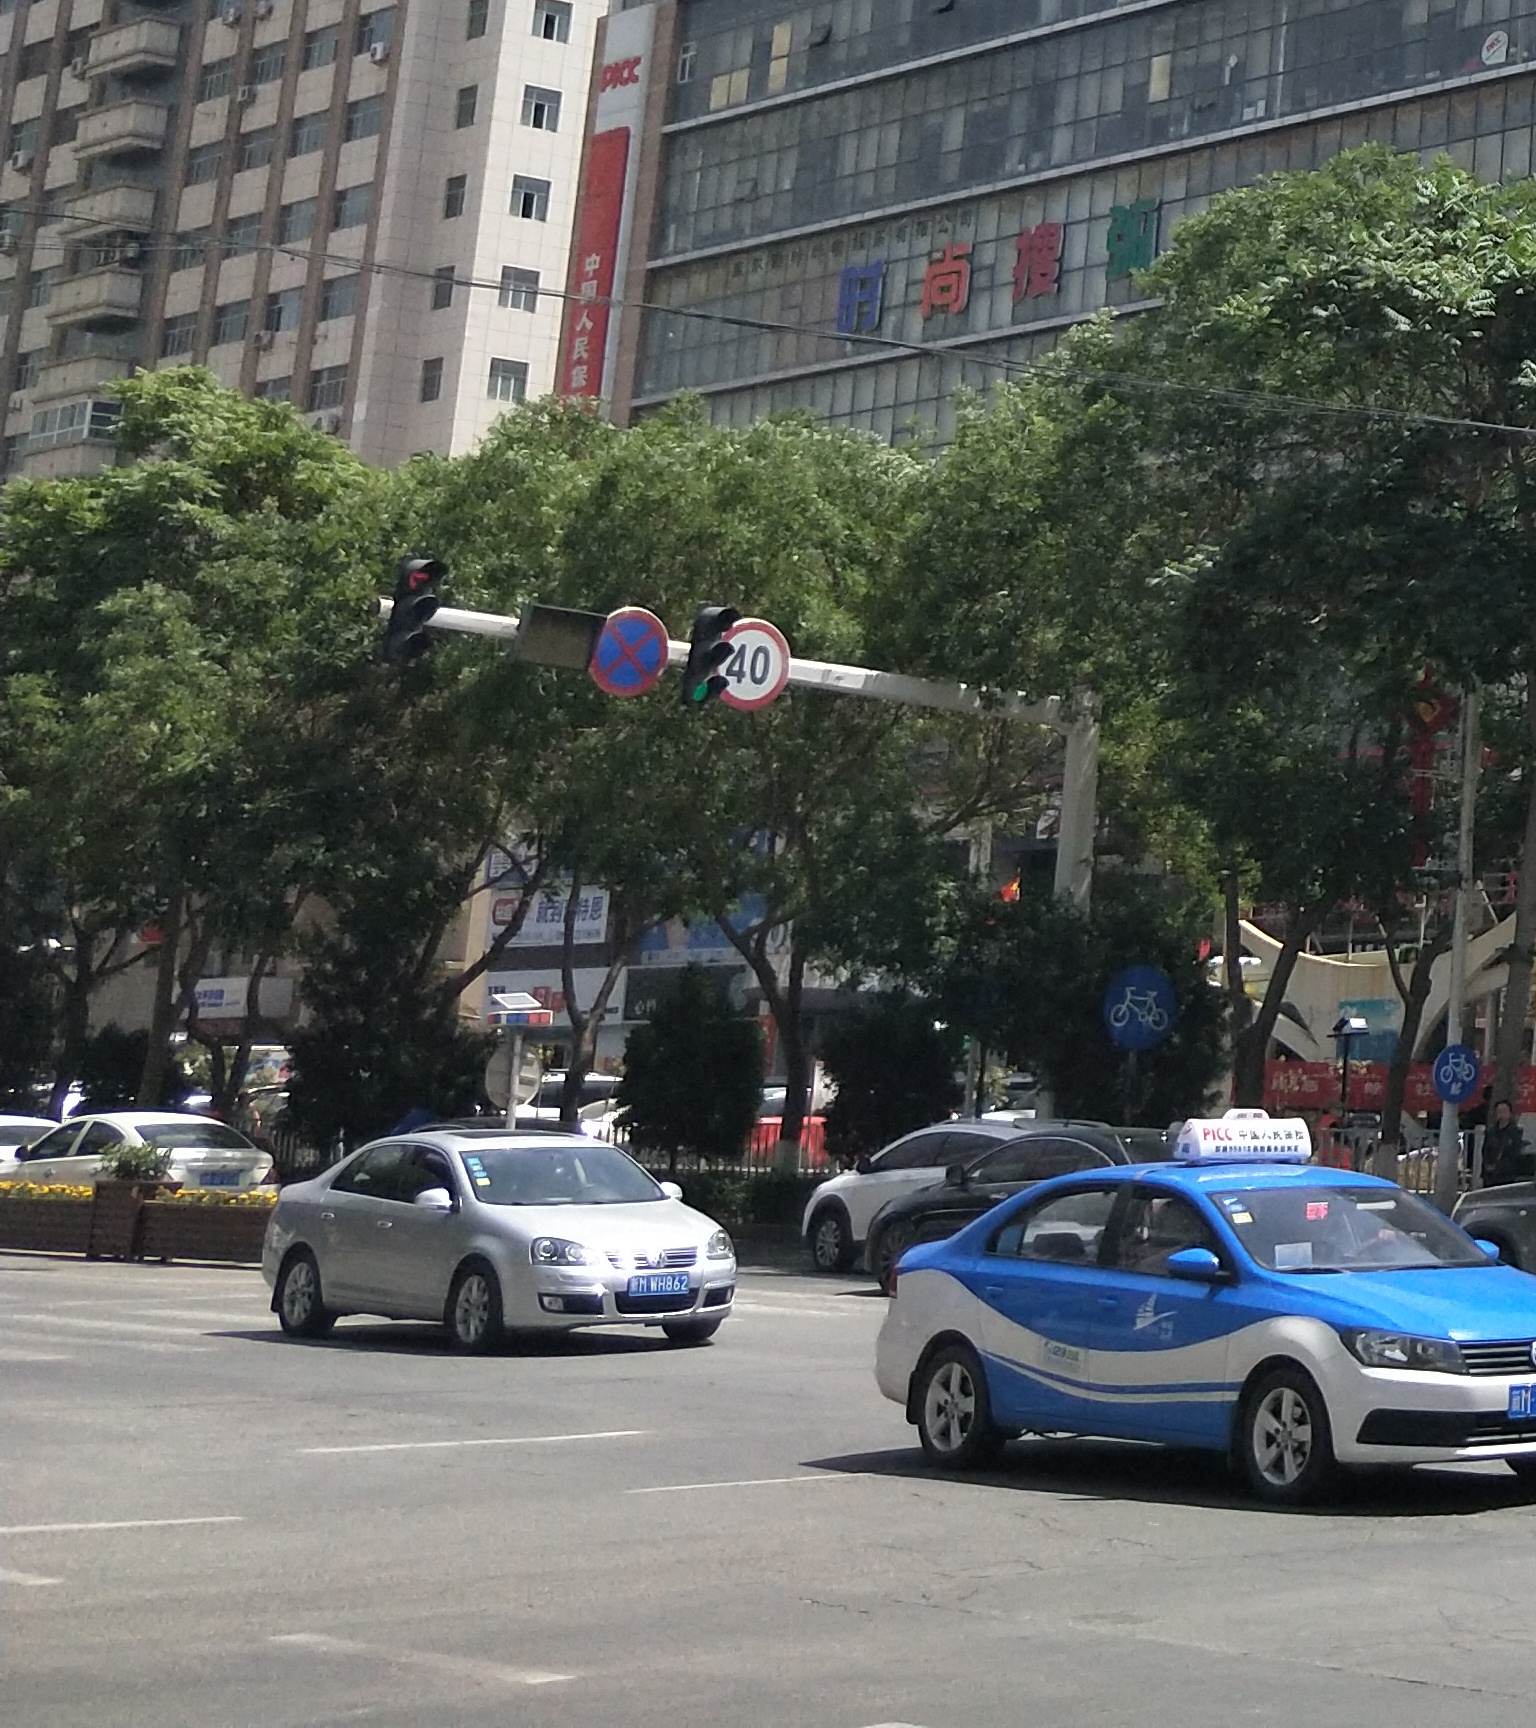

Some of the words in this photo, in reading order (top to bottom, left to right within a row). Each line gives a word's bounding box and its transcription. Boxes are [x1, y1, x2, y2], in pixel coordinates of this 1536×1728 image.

[571, 252, 601, 412] 中国人民保
[725, 644, 771, 685] 40
[1203, 1127, 1233, 1141] PICC
